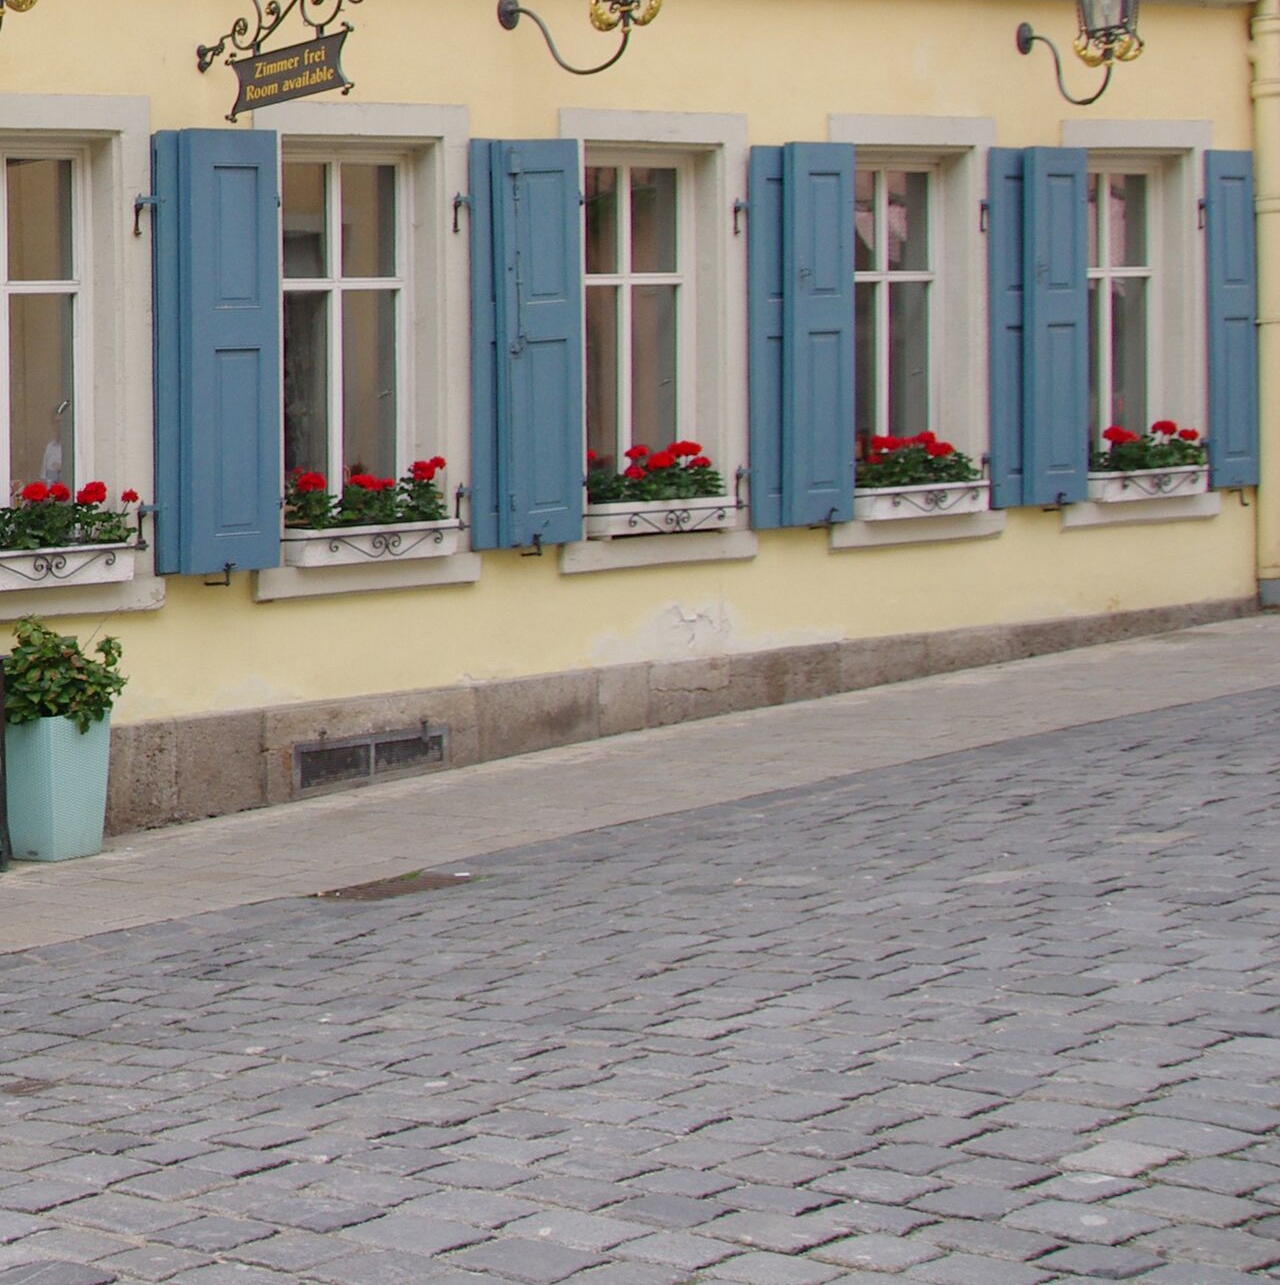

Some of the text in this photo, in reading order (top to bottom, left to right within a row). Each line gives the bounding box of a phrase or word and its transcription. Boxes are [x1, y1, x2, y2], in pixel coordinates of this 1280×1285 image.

[254, 46, 326, 78] Zimmer frei
[246, 66, 335, 101] Room available
